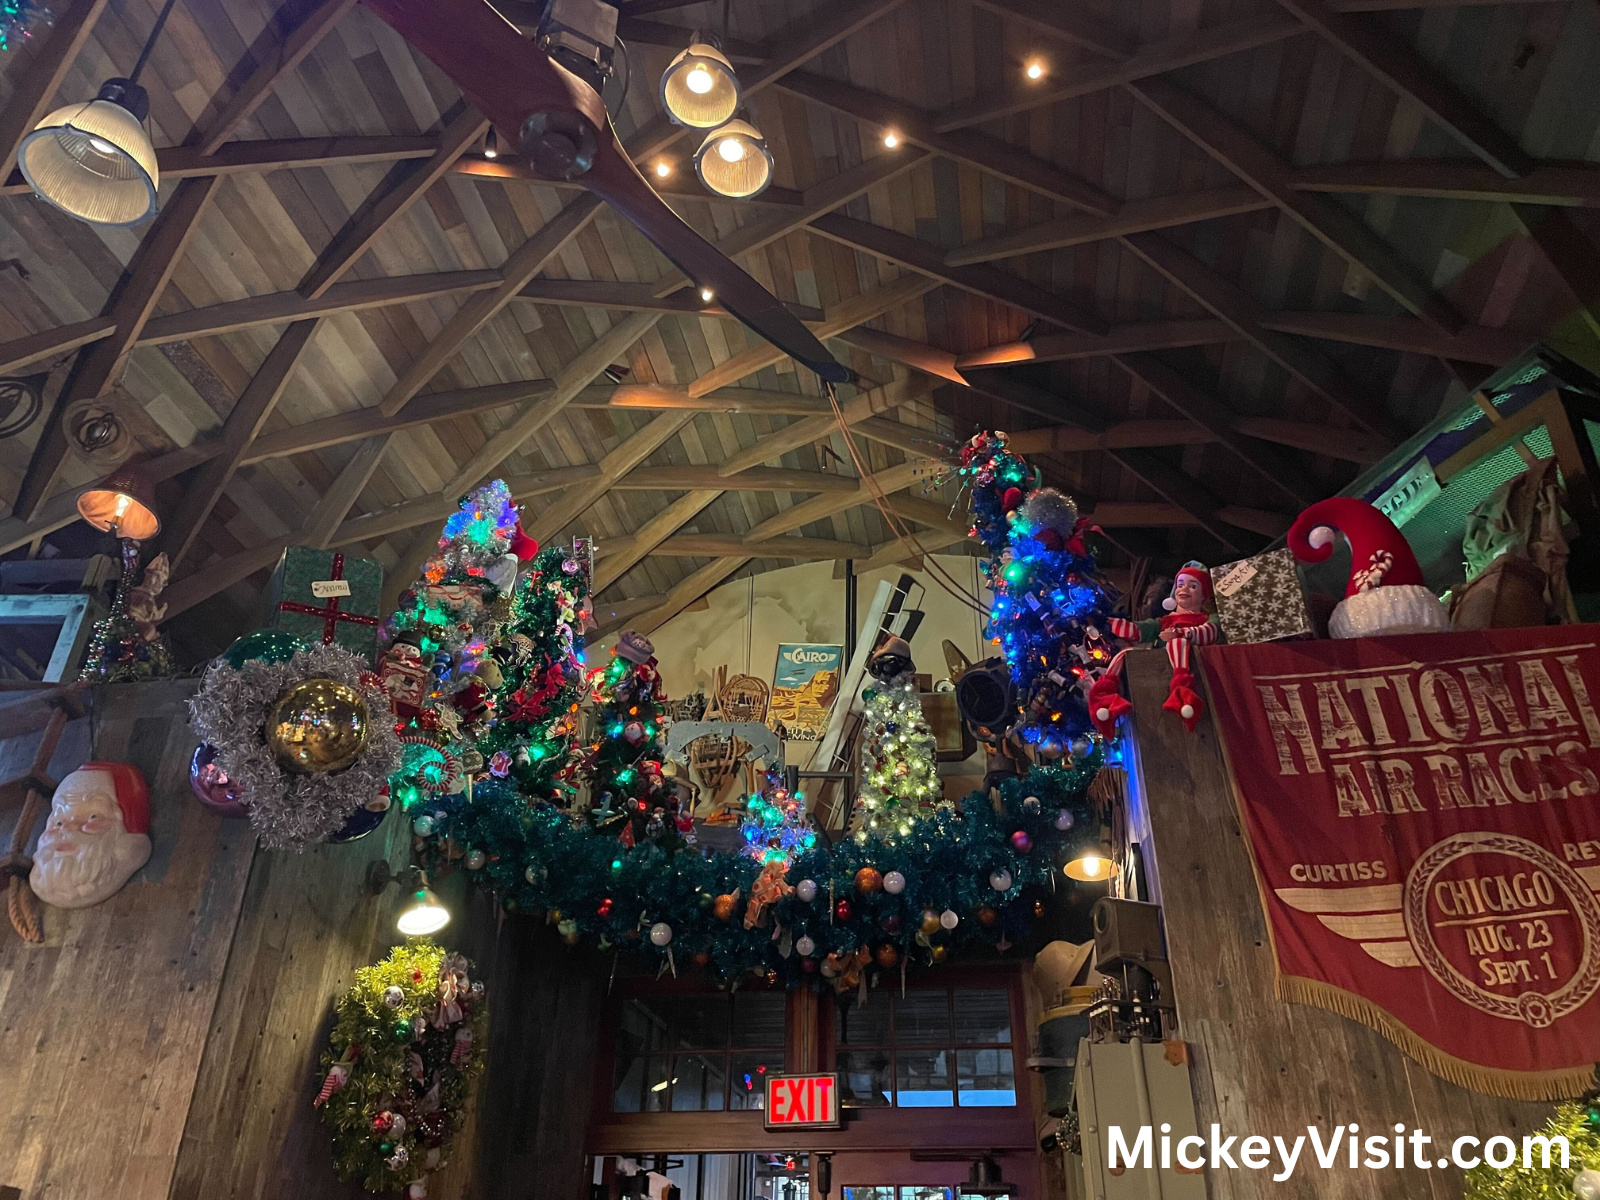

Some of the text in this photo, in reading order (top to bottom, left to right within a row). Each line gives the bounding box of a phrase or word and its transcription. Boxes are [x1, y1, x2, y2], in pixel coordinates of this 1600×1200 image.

[792, 648, 829, 665] CAIRO
[1332, 740, 1600, 817] AIR RACES
[1290, 861, 1388, 883] CURTISS
[1434, 870, 1555, 916] CHICAGO
[1465, 919, 1554, 956] AUG. 23
[1540, 951, 1558, 980] 1
[770, 1078, 833, 1123] EXIT
